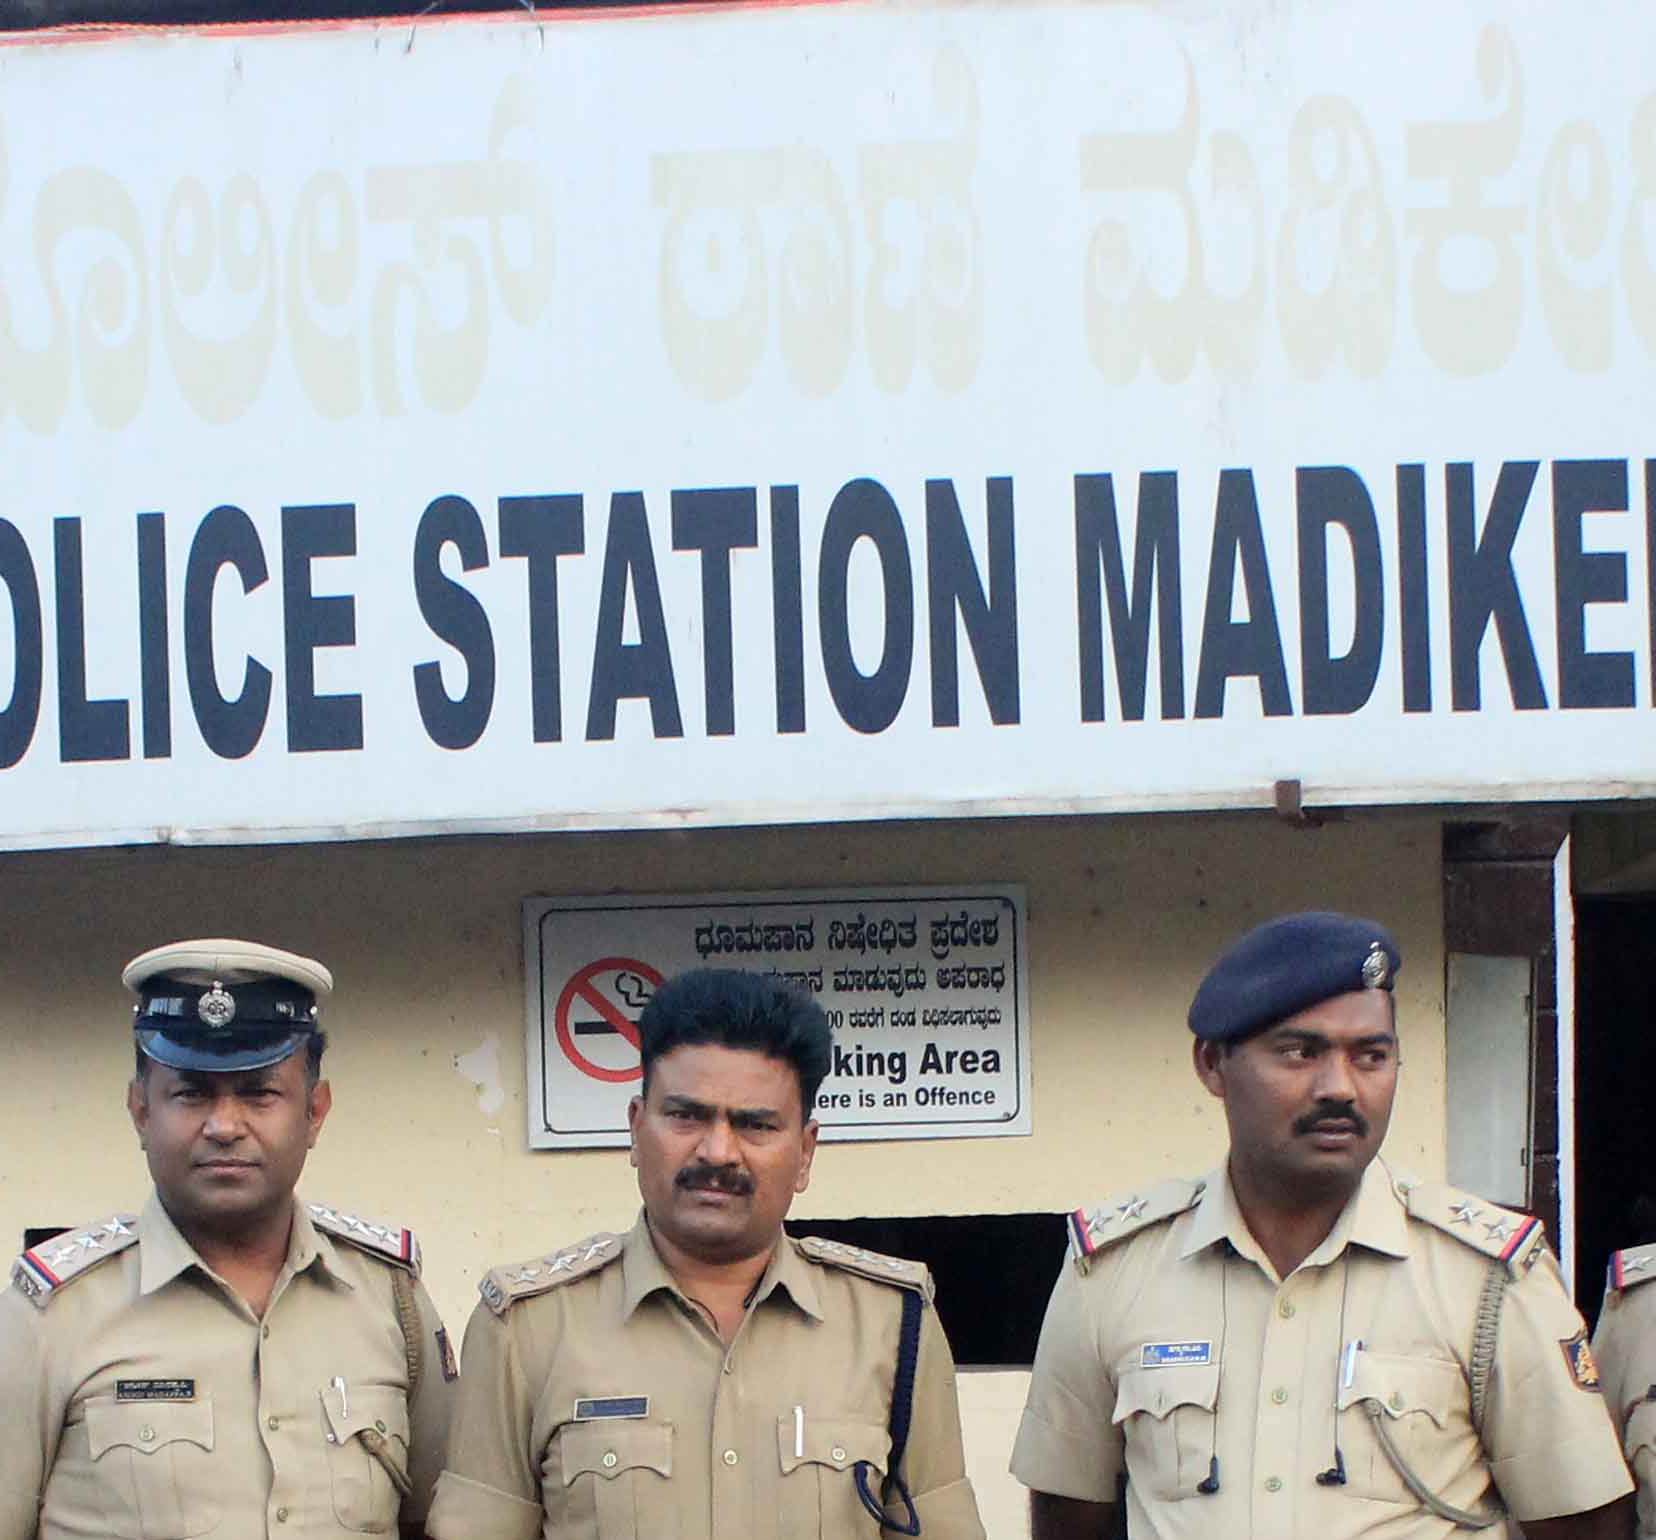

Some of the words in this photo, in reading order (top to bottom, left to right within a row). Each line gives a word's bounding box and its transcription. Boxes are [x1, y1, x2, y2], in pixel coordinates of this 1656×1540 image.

[650, 42, 984, 402] ಠಾಣೆ
[414, 477, 1020, 749] STATION
[695, 916, 815, 960] ಧೂಮಪಾನ
[828, 912, 918, 956] ನಿಷೇಧಿತ
[930, 910, 1000, 960] ಪ್ರದೇಶ
[936, 960, 1005, 993] ಅಪರಾಧ
[826, 1044, 907, 1085] king
[919, 1043, 1001, 1075] Area
[813, 1090, 851, 1109] ere
[859, 1089, 876, 1107] is
[883, 1092, 907, 1107] an
[915, 1087, 996, 1106] Offence
